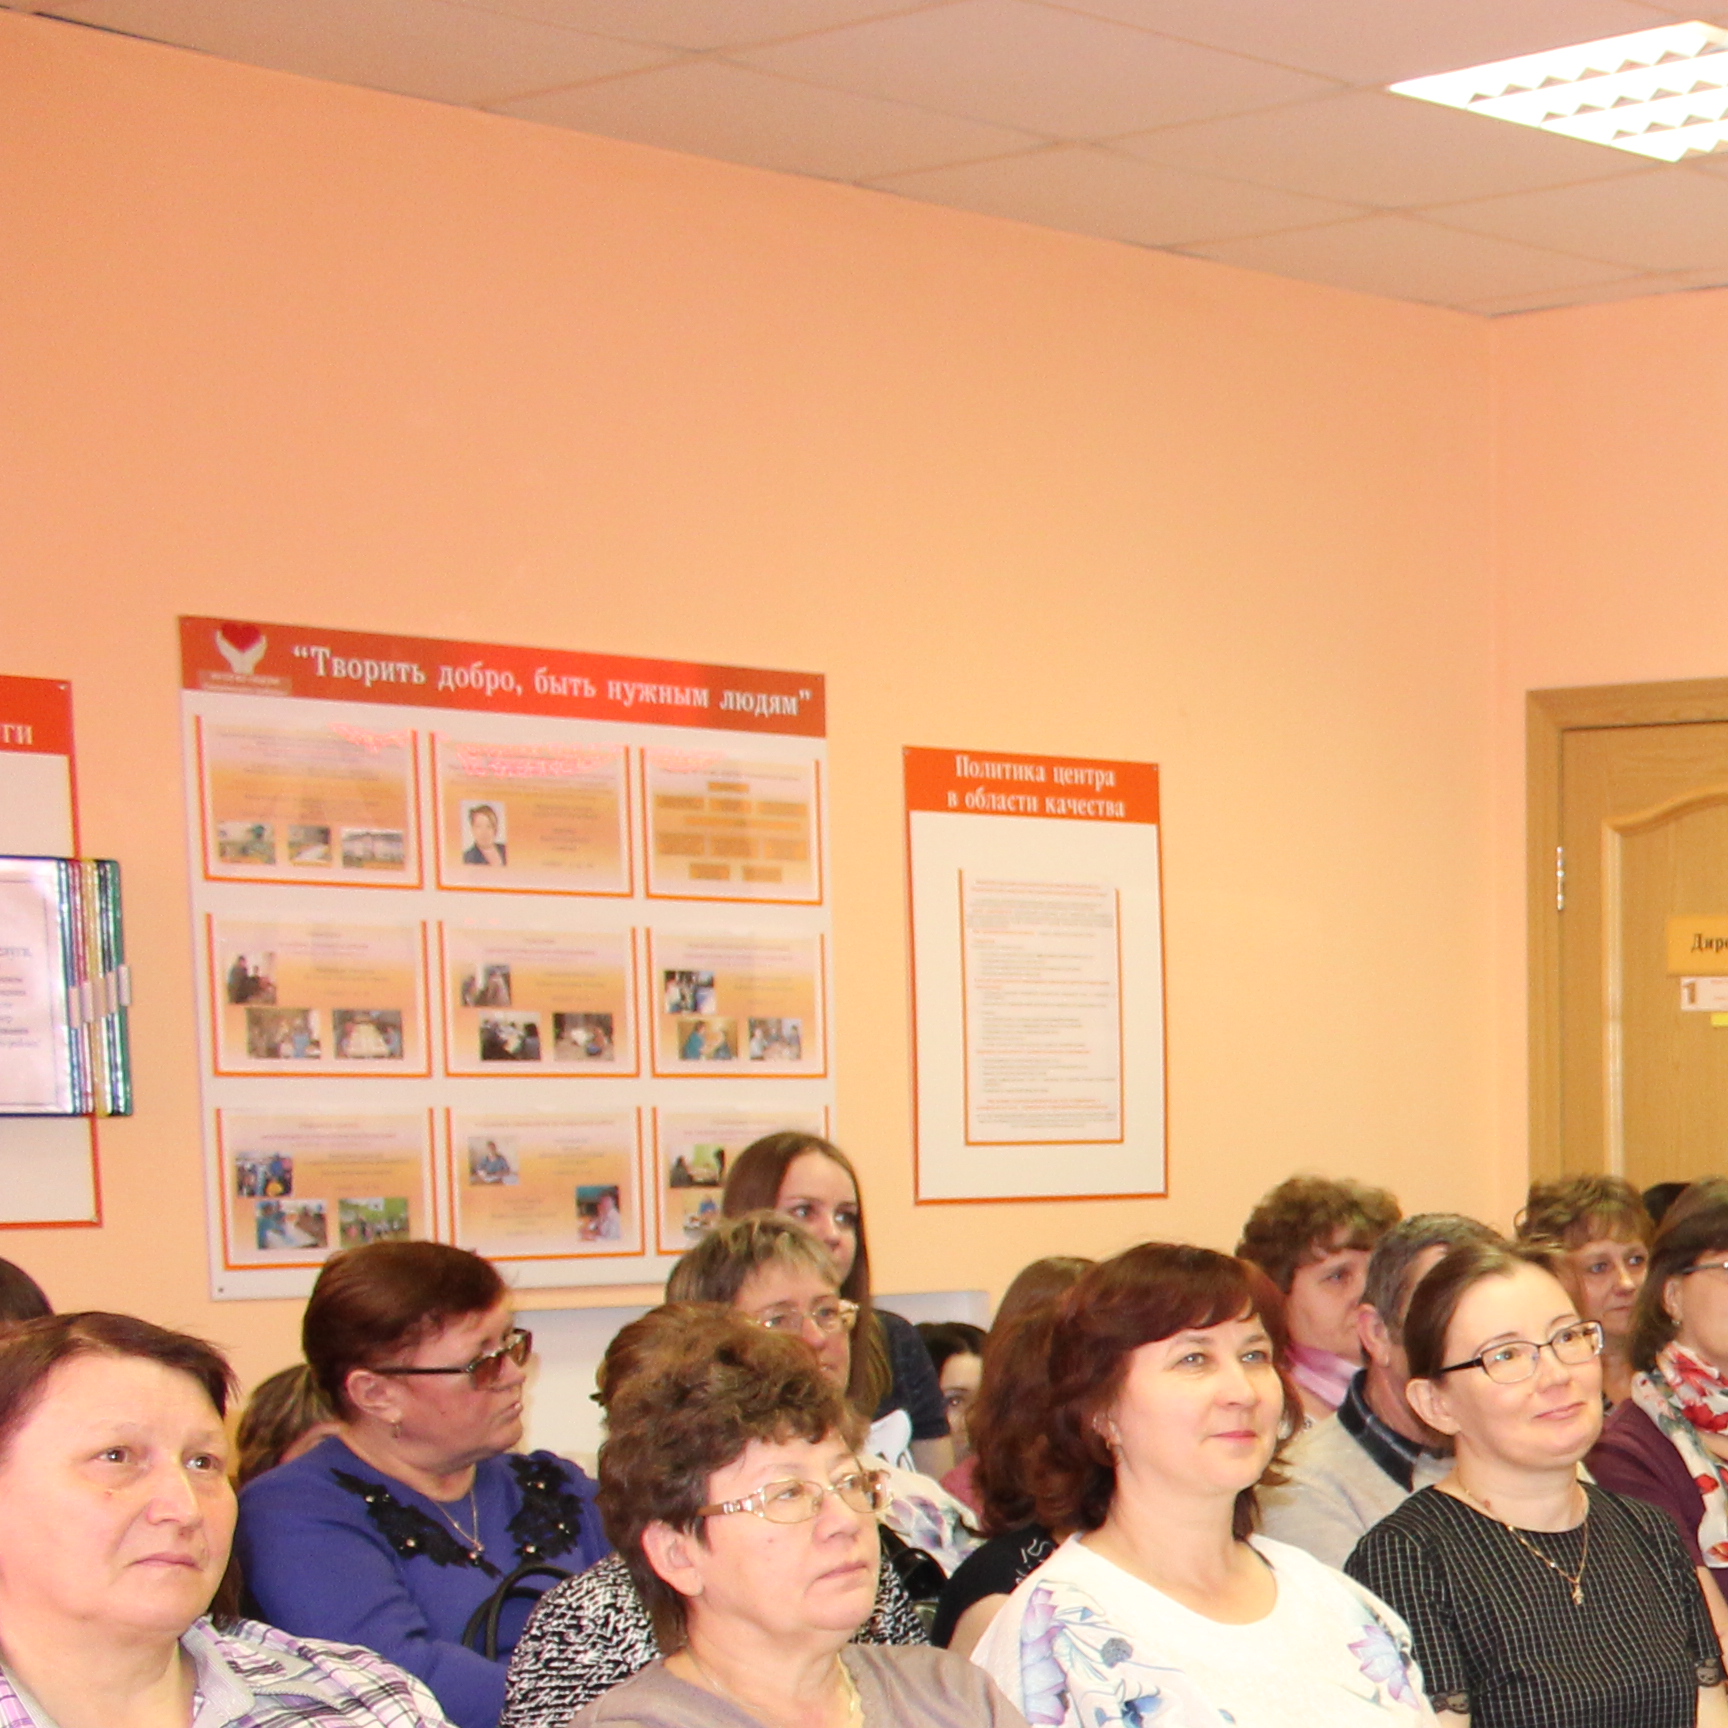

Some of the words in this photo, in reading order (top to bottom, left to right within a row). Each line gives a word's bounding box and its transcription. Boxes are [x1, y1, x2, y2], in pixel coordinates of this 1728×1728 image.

[437, 660, 523, 697] добро,
[534, 665, 597, 698] быть
[607, 678, 710, 708] нужным
[955, 754, 1047, 783] Политика
[1053, 765, 1117, 793] центра
[947, 790, 959, 808] в
[964, 786, 1039, 813] области
[1045, 796, 1127, 819] качества
